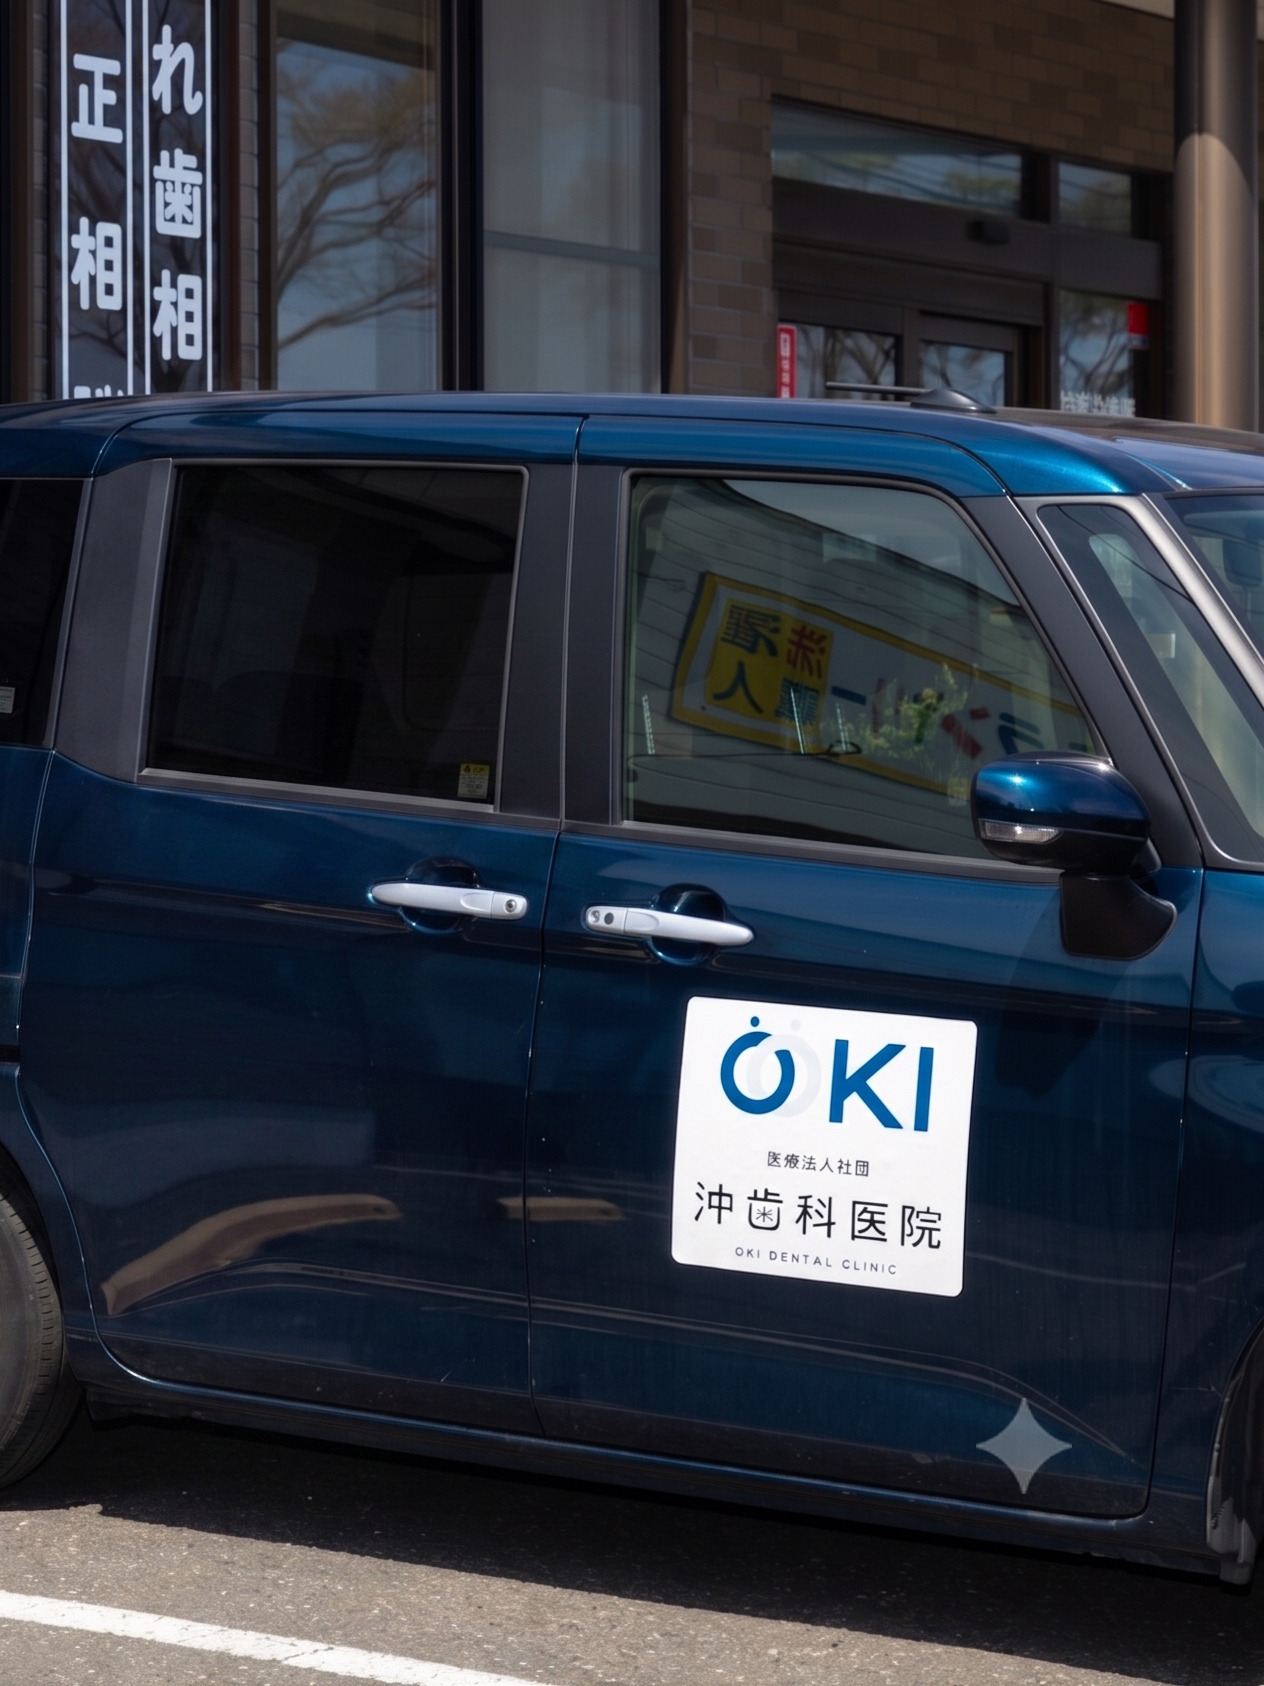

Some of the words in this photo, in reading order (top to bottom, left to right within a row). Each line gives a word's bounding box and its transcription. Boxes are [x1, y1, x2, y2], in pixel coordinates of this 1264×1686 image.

[720, 1016, 935, 1133] OKI
[693, 1181, 943, 1250] 沖歯科医院
[734, 1246, 761, 1260] OKI
[768, 1250, 833, 1268] DENTAL
[841, 1259, 898, 1276] CLINIC
